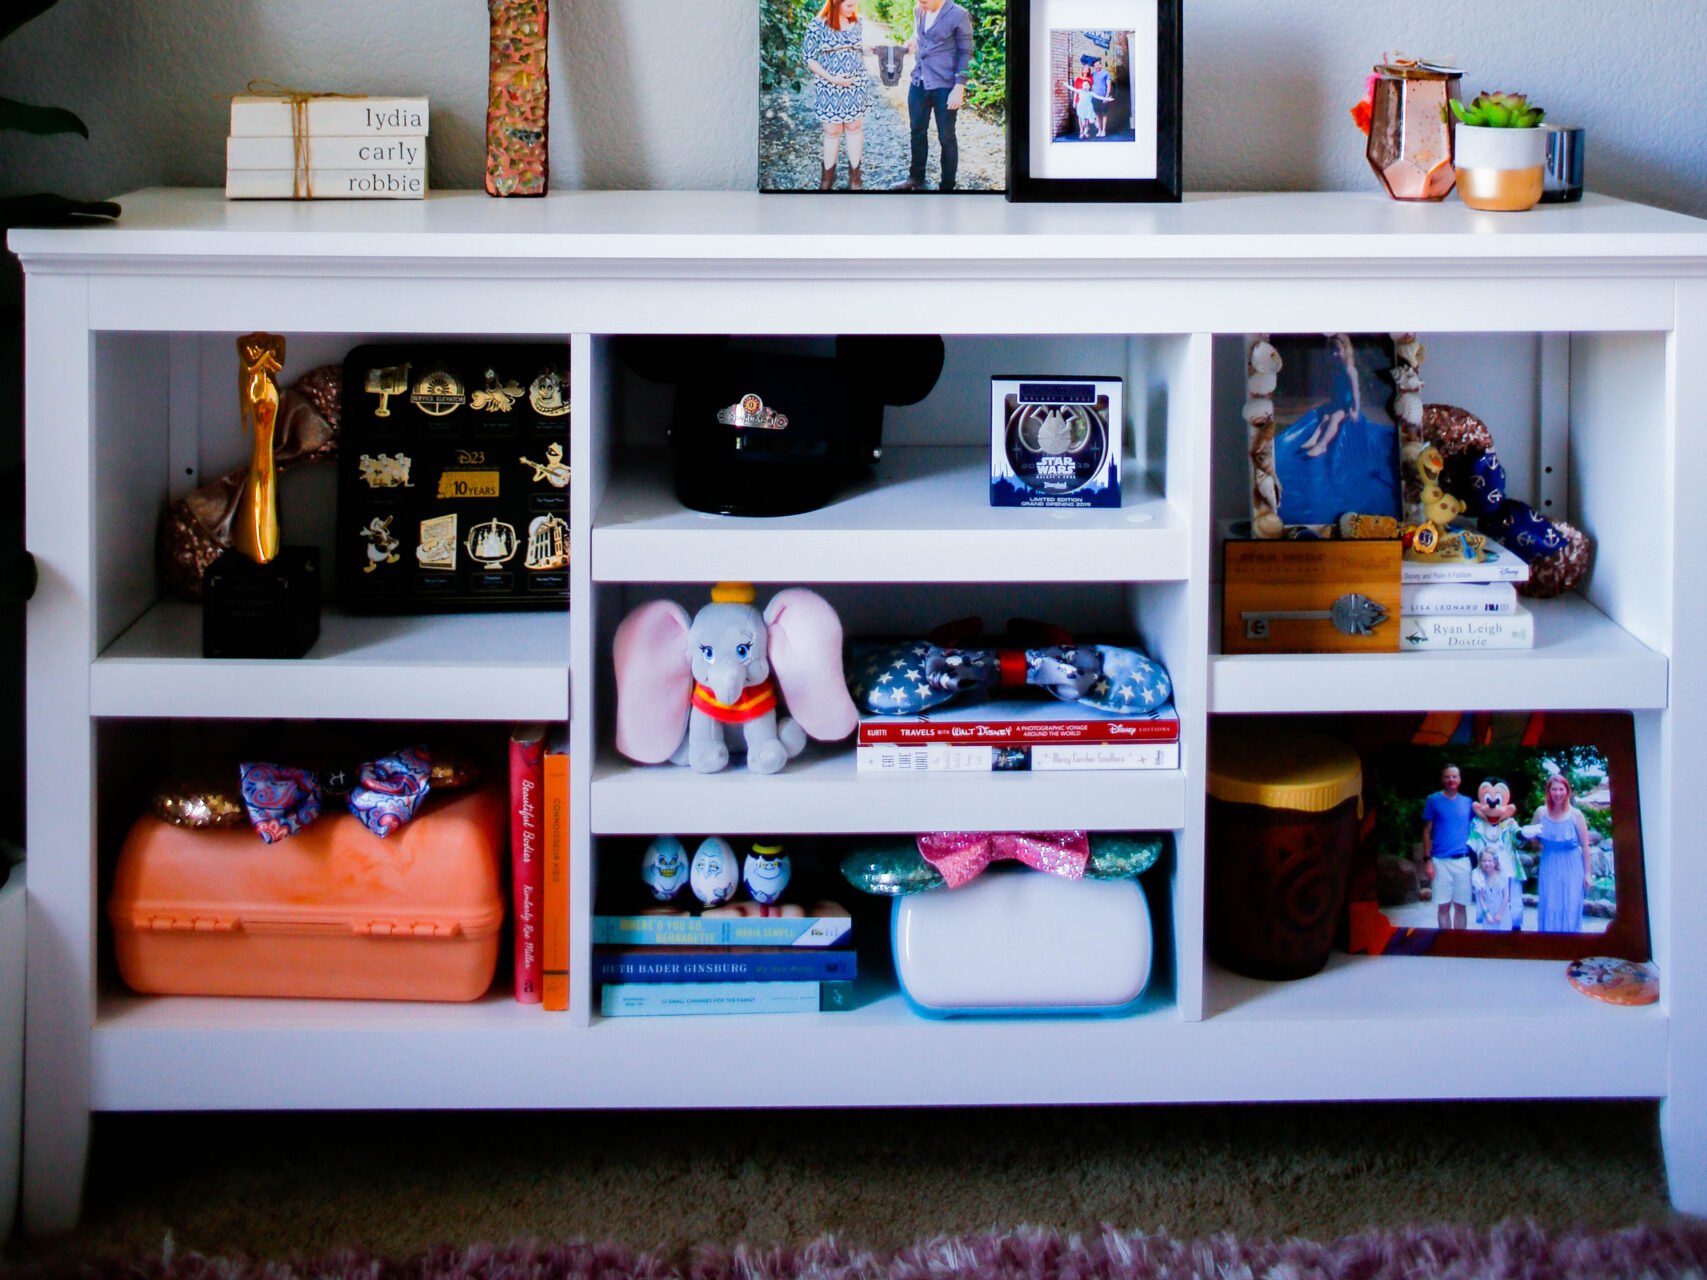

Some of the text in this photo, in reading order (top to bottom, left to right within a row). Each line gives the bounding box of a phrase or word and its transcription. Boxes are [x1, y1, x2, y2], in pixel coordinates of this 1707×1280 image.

[365, 107, 422, 130] lydia
[358, 141, 418, 165] carly
[349, 173, 421, 192] robbie
[456, 449, 485, 464] D23
[1036, 456, 1075, 465] STAR
[1036, 465, 1076, 475] WARS
[454, 480, 497, 496] 10 YEARS
[1433, 623, 1463, 636] Ryan
[1467, 623, 1503, 636] Leigh
[1447, 636, 1488, 646] Dostie
[900, 728, 936, 737] TRAVELS
[1107, 723, 1137, 735] Disney
[518, 779, 535, 863] Beautiful Bodies
[552, 798, 561, 860] CONNOISSEUR
[520, 884, 534, 921] Kimberly
[523, 941, 534, 969] Miller
[602, 962, 747, 974] RUTH BADER GINSBURG
